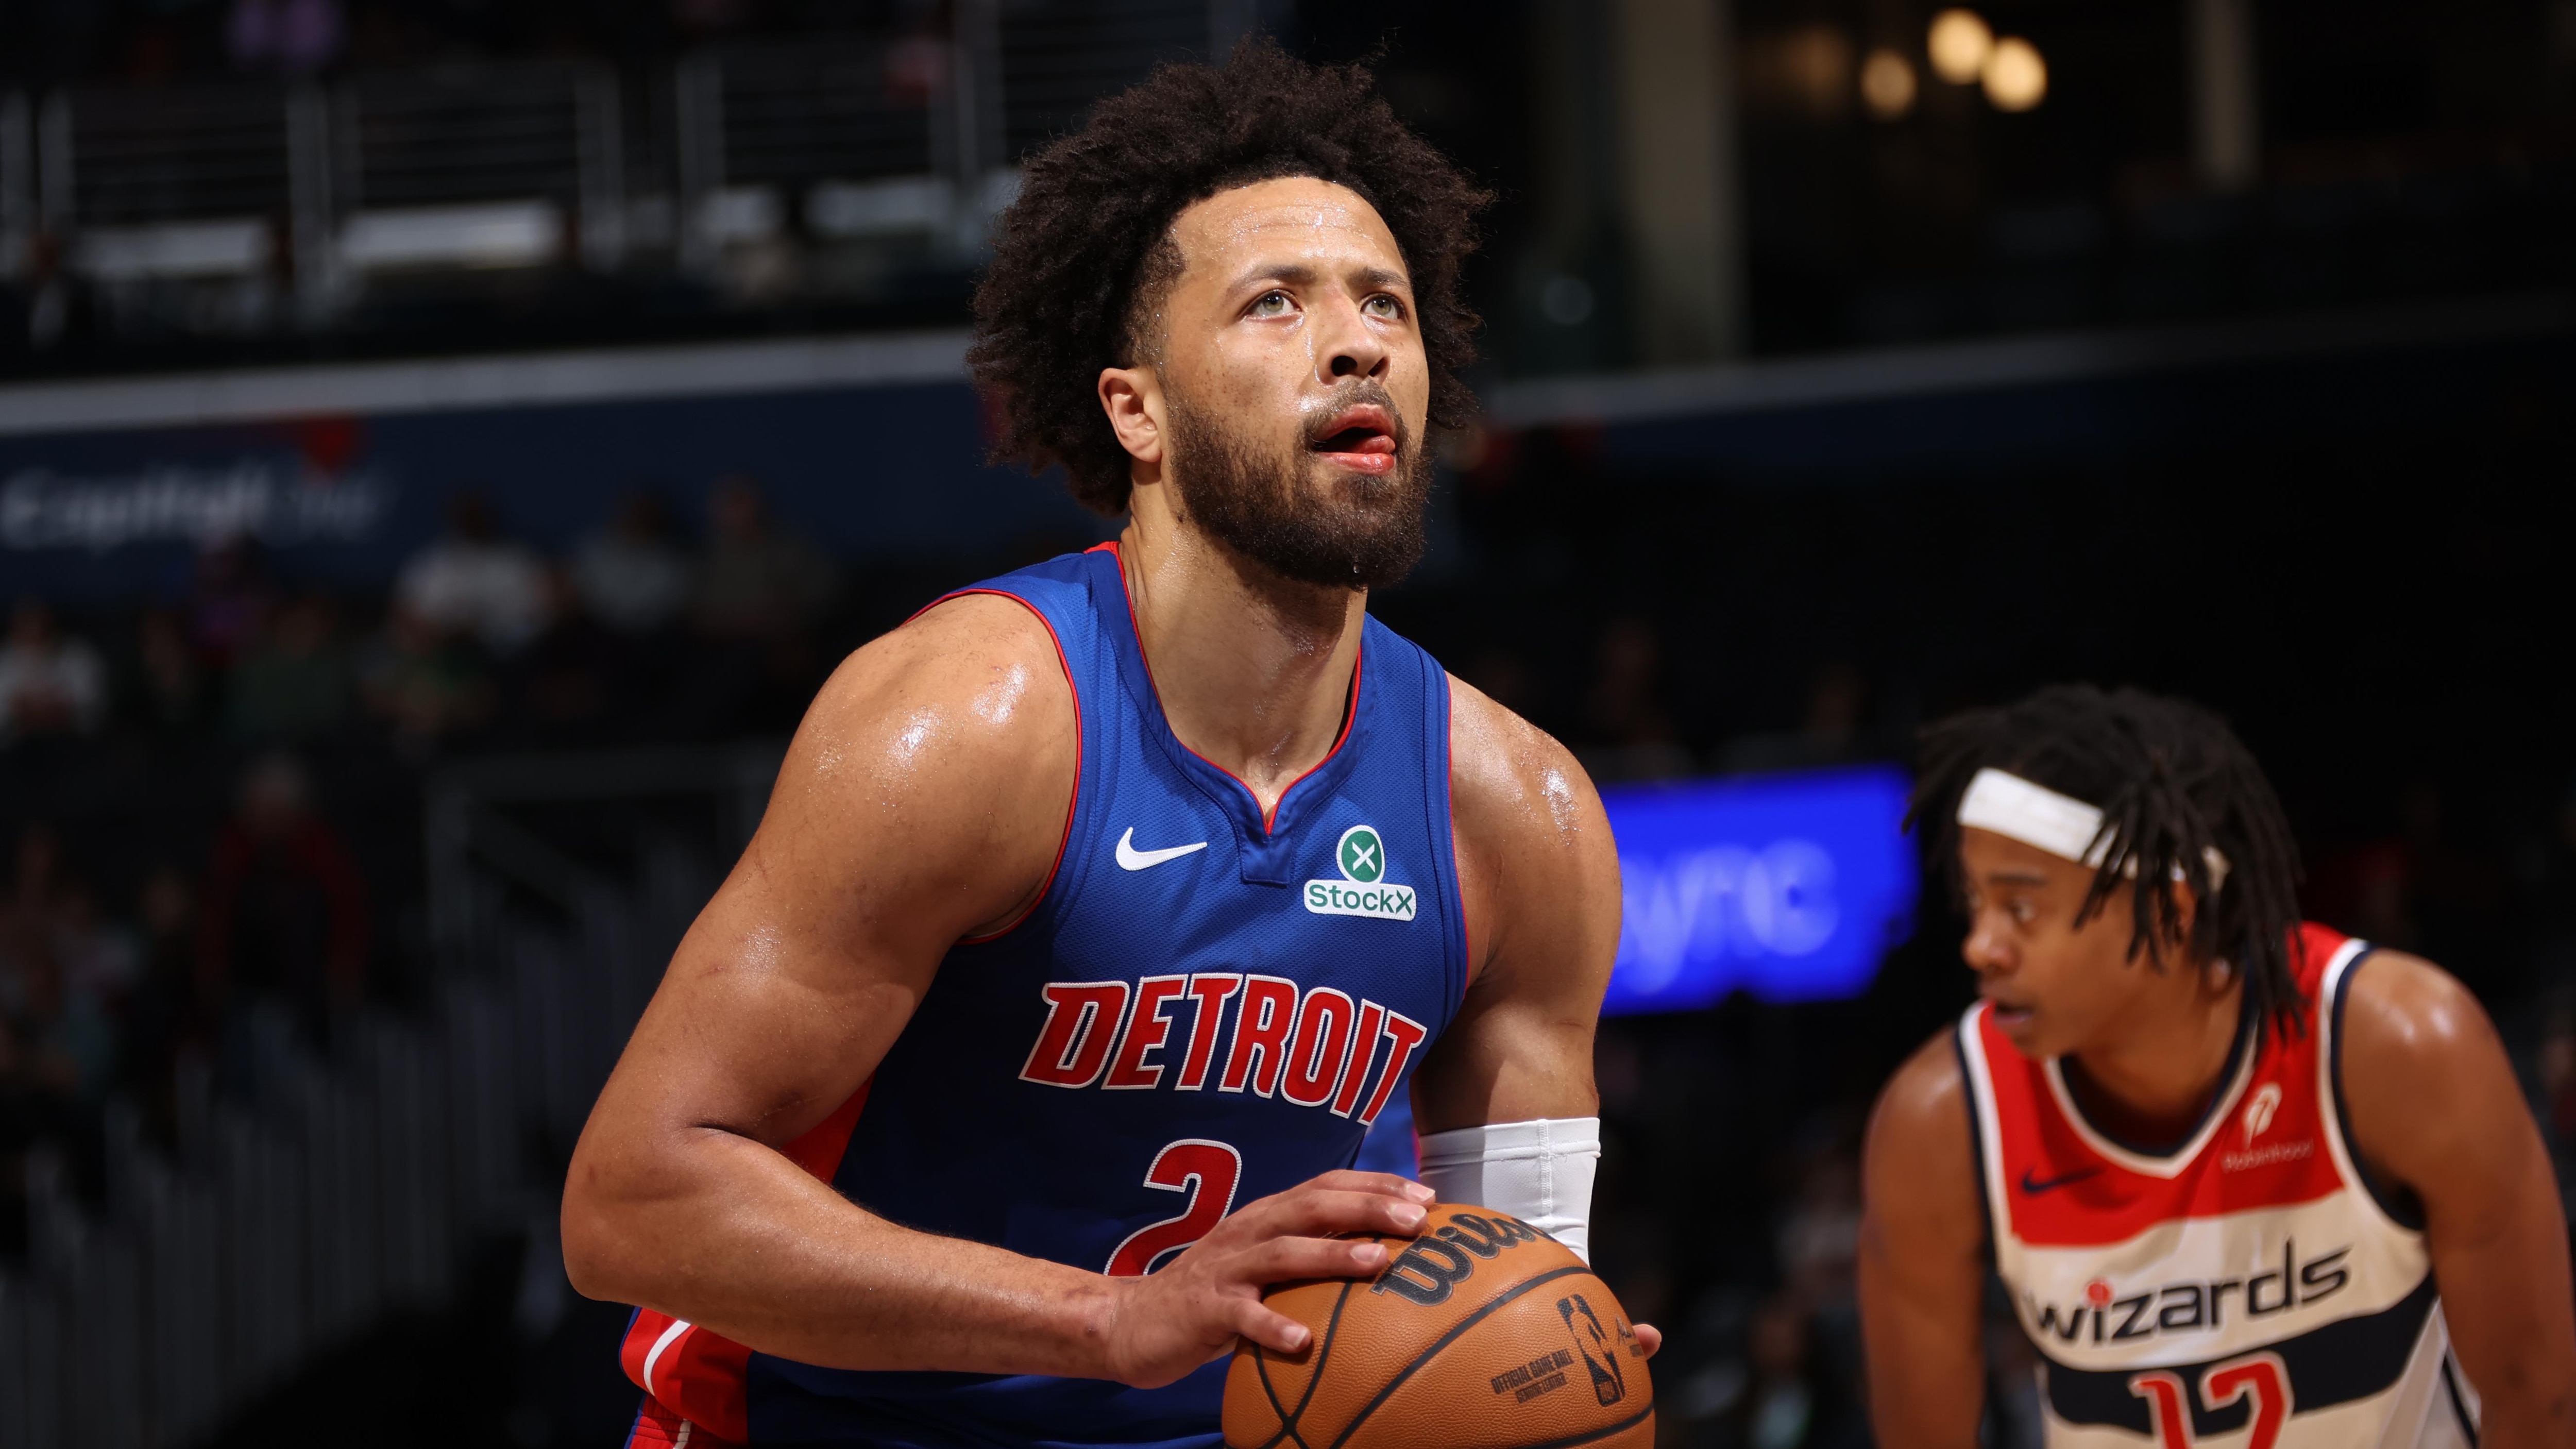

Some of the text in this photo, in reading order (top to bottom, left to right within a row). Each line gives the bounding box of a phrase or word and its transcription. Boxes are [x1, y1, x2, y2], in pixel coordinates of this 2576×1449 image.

[1309, 884, 1412, 916] StockX
[1019, 973, 1427, 1125] DETROIT
[1103, 1138, 1242, 1276] 2
[2025, 1235, 2353, 1347] wizards
[1490, 1349, 1574, 1394] OFFICIAL GAME BALL
